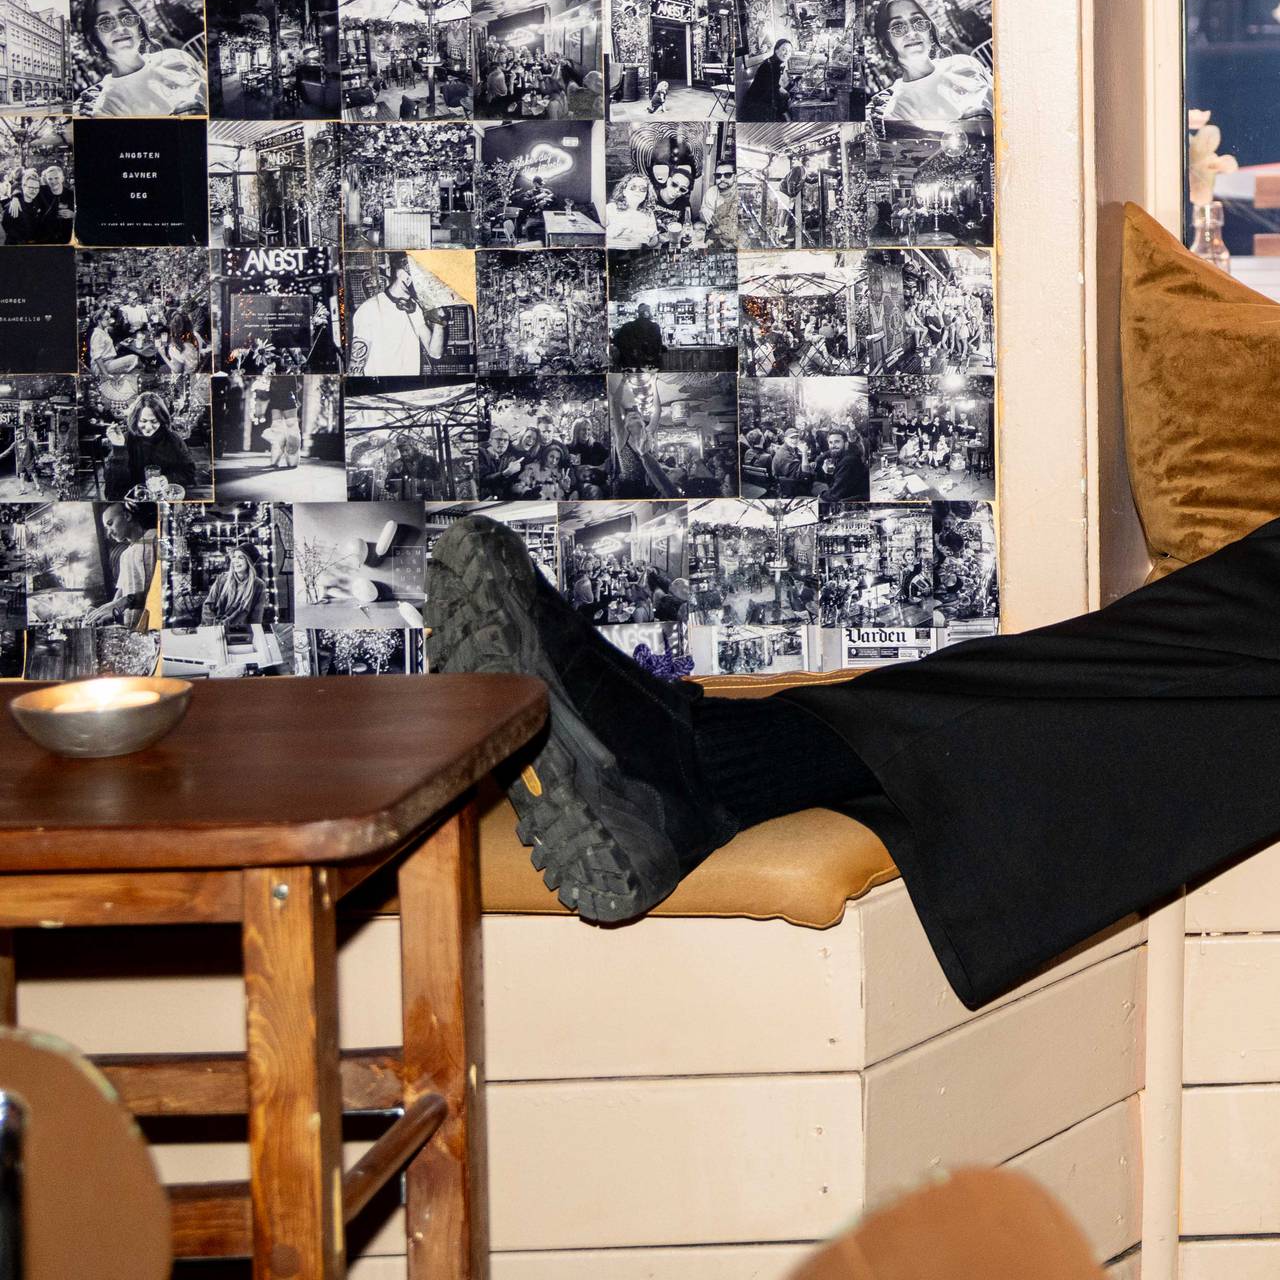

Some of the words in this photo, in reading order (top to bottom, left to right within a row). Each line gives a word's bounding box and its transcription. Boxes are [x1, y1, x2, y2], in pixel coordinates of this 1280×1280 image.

[119, 151, 161, 160] ANGSTEN
[122, 171, 158, 180] SAVNER
[129, 192, 148, 200] DEG
[243, 249, 309, 272] ANGST
